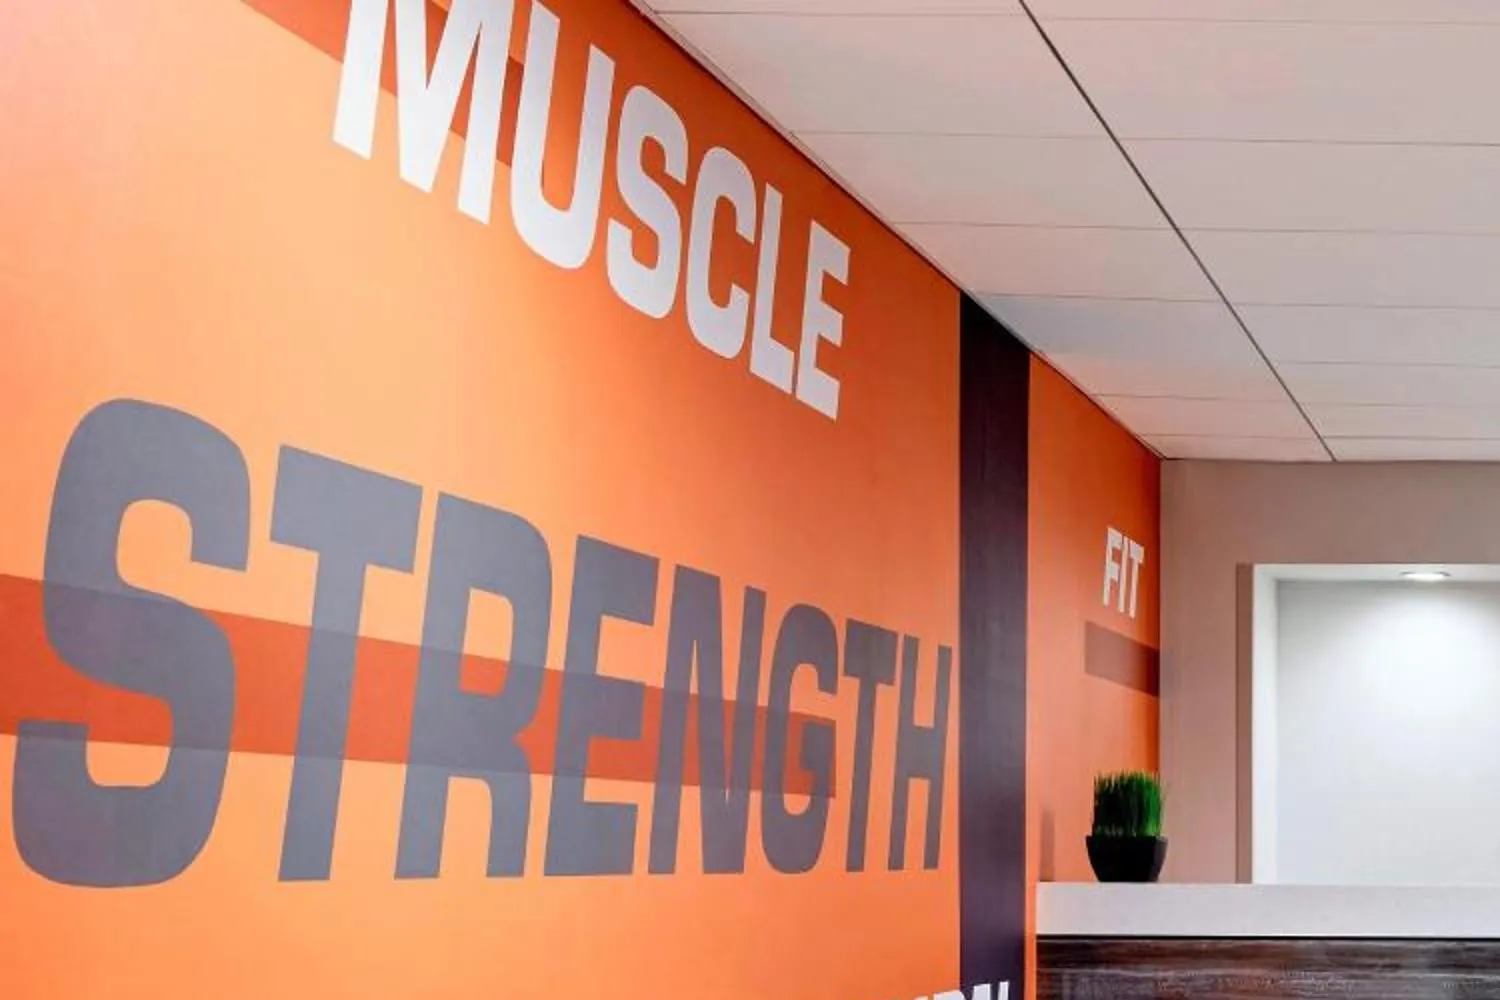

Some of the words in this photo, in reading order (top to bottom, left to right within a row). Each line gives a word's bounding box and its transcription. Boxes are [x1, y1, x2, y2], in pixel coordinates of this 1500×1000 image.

[332, 0, 851, 421] MUSCLE
[12, 398, 953, 888] STRENGTH
[1103, 526, 1145, 619] FIT
